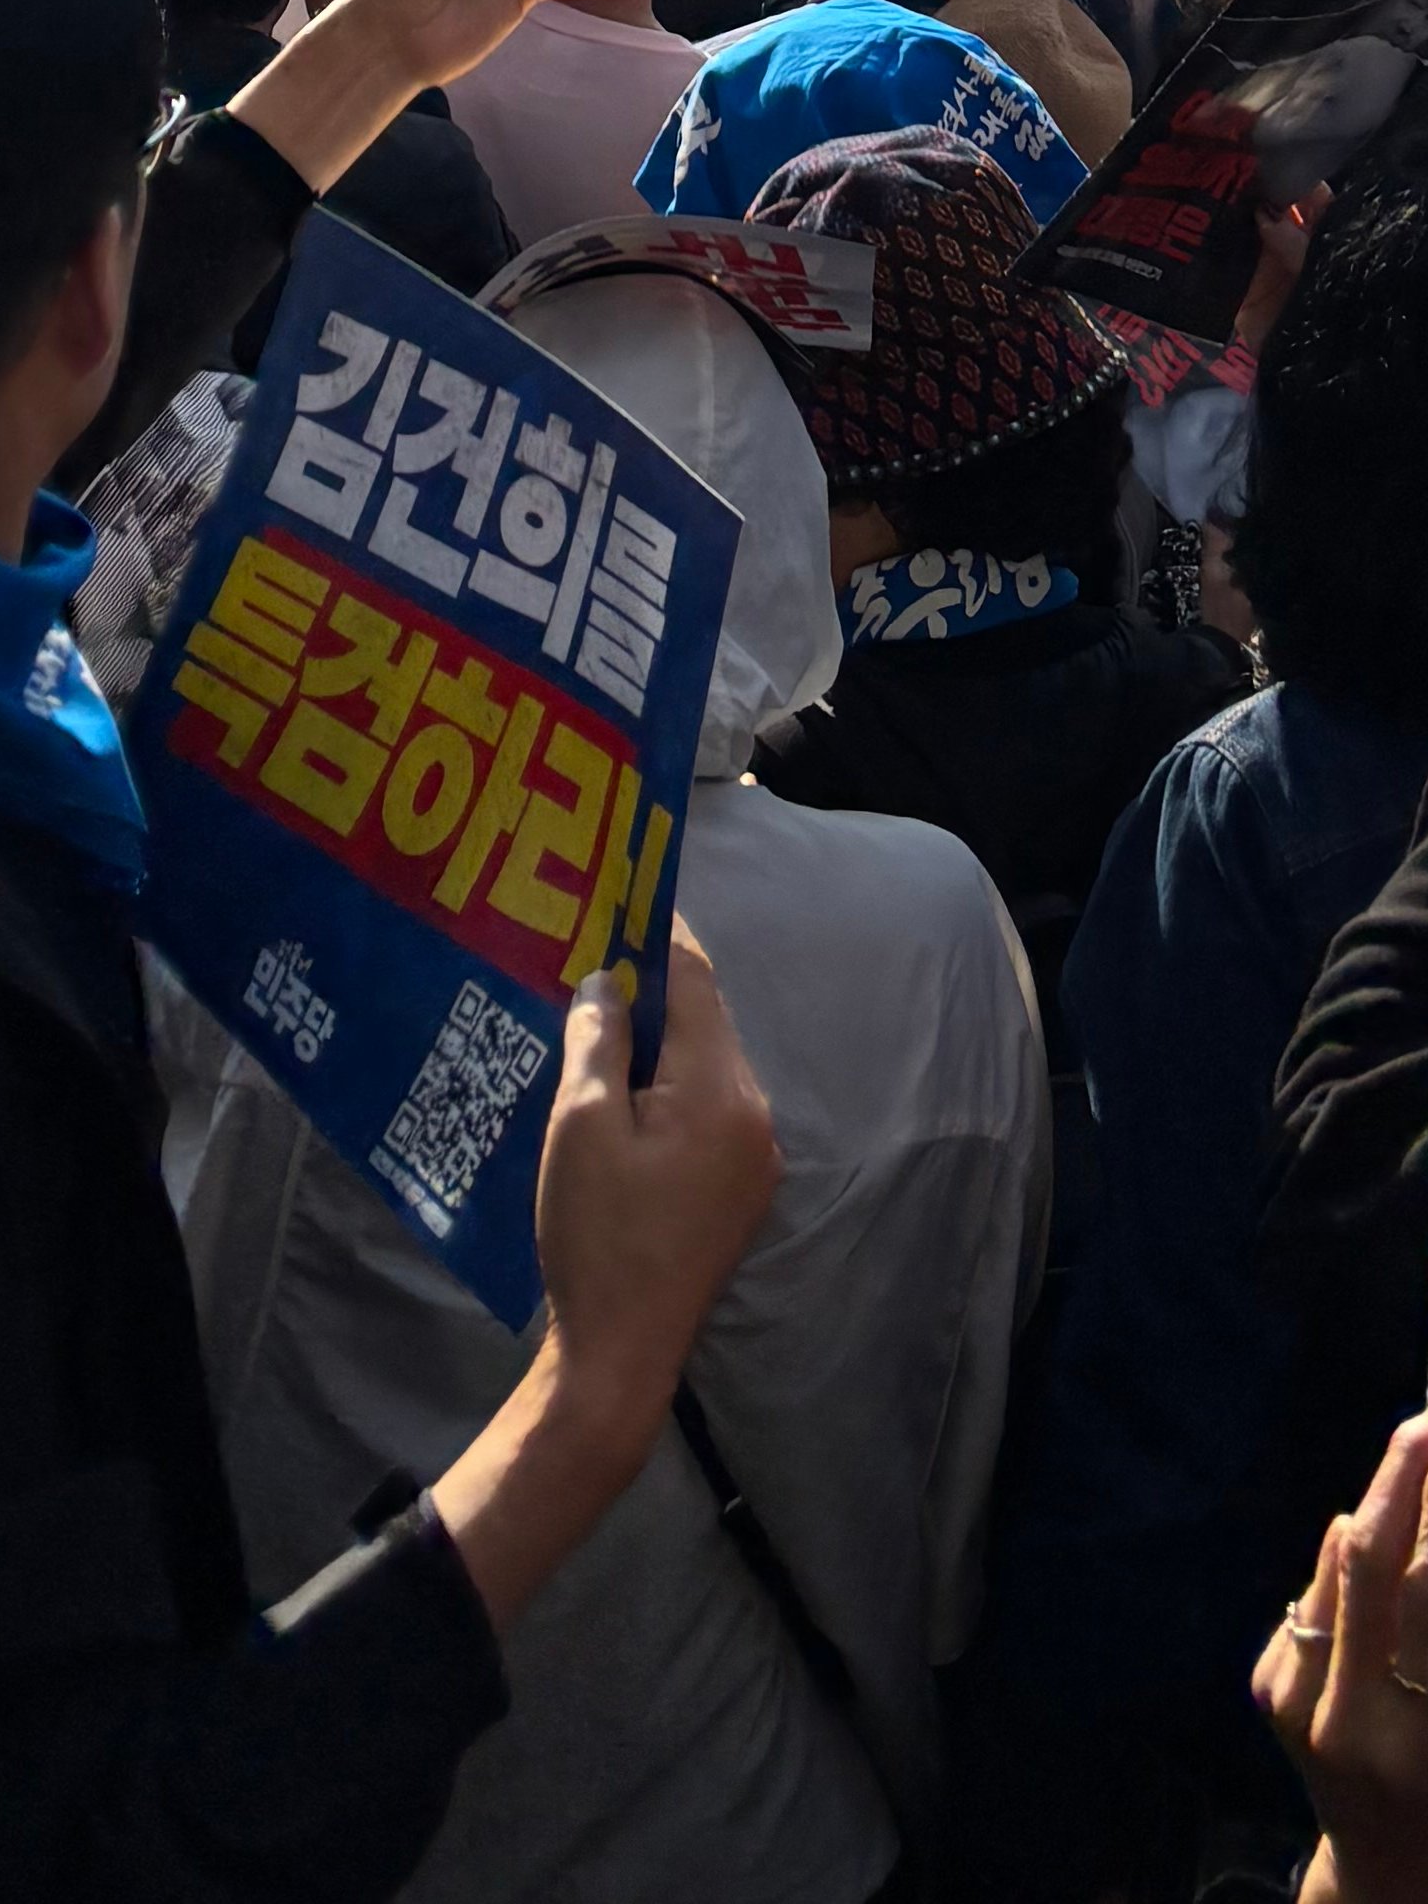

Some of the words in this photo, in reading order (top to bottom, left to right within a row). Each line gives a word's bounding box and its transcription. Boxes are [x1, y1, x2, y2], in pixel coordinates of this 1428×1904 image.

[264, 310, 677, 716] 김건희를
[174, 535, 672, 1004] 특검하라!
[243, 947, 335, 1063] 민주당
